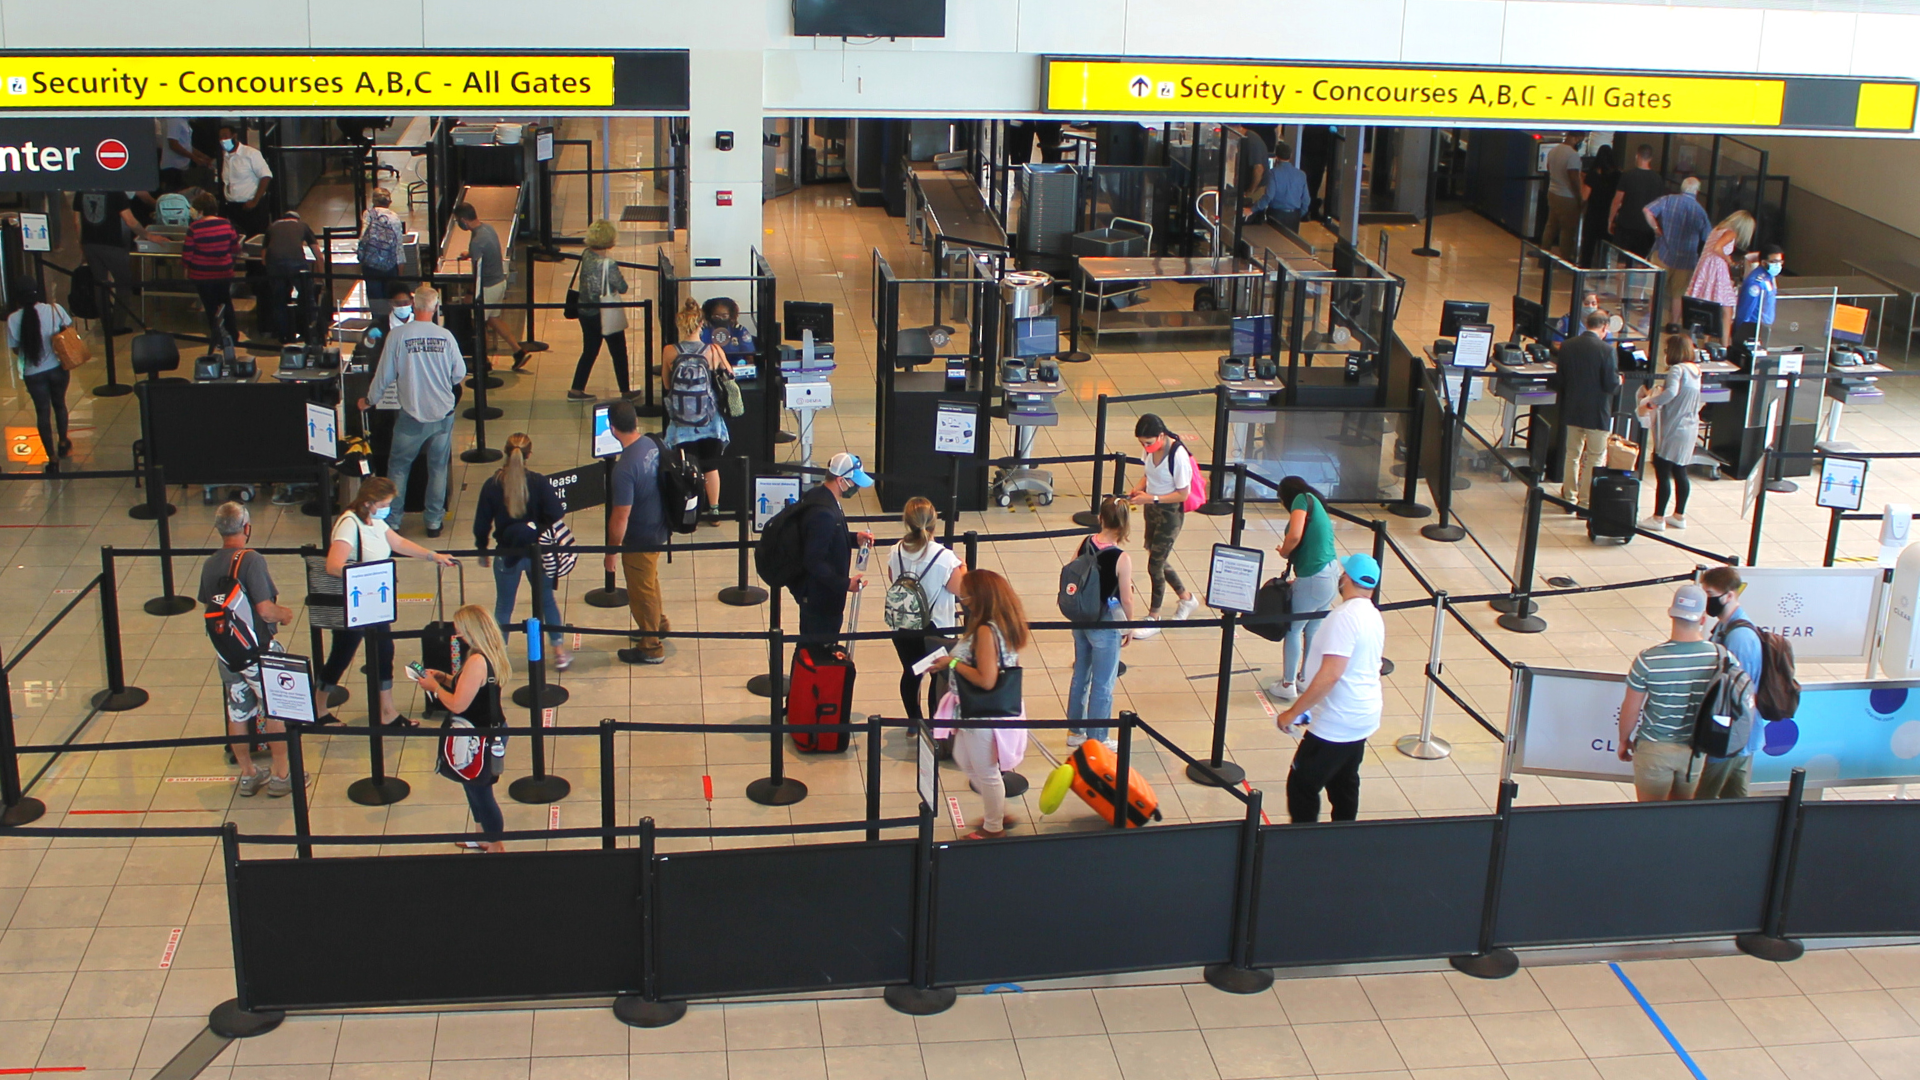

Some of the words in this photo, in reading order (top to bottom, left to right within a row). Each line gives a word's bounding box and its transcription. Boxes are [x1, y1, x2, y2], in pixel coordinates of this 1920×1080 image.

[33, 67, 148, 100] Security
[179, 70, 343, 93] Concourses
[355, 71, 432, 97] A,B,C
[462, 70, 499, 93] All
[511, 71, 591, 94] Gates
[1180, 75, 1285, 105] Security
[1312, 79, 1458, 104] Concourses
[1468, 84, 1537, 107] A,B,C
[1562, 85, 1595, 107] All
[1604, 86, 1672, 109] Gates
